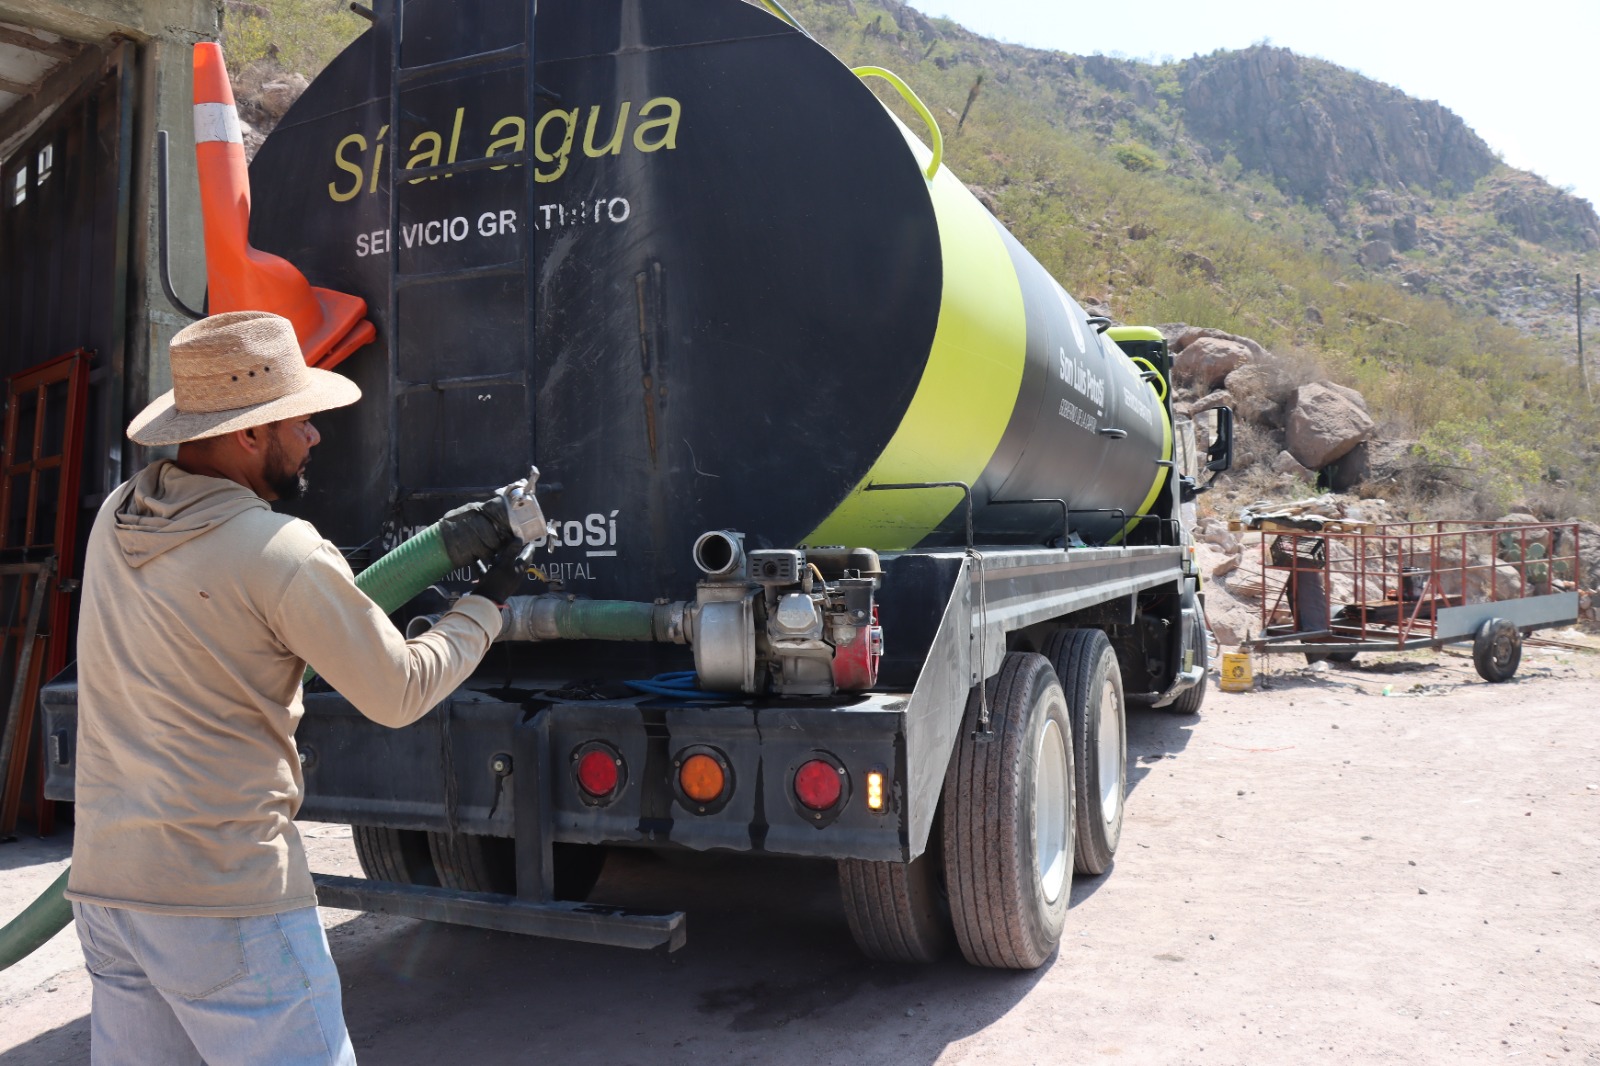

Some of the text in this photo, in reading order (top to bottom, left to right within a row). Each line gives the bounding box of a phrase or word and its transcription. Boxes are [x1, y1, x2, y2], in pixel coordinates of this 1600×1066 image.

[328, 96, 682, 203] Sí al agua
[1059, 347, 1073, 386] San
[1073, 358, 1086, 395] Luis
